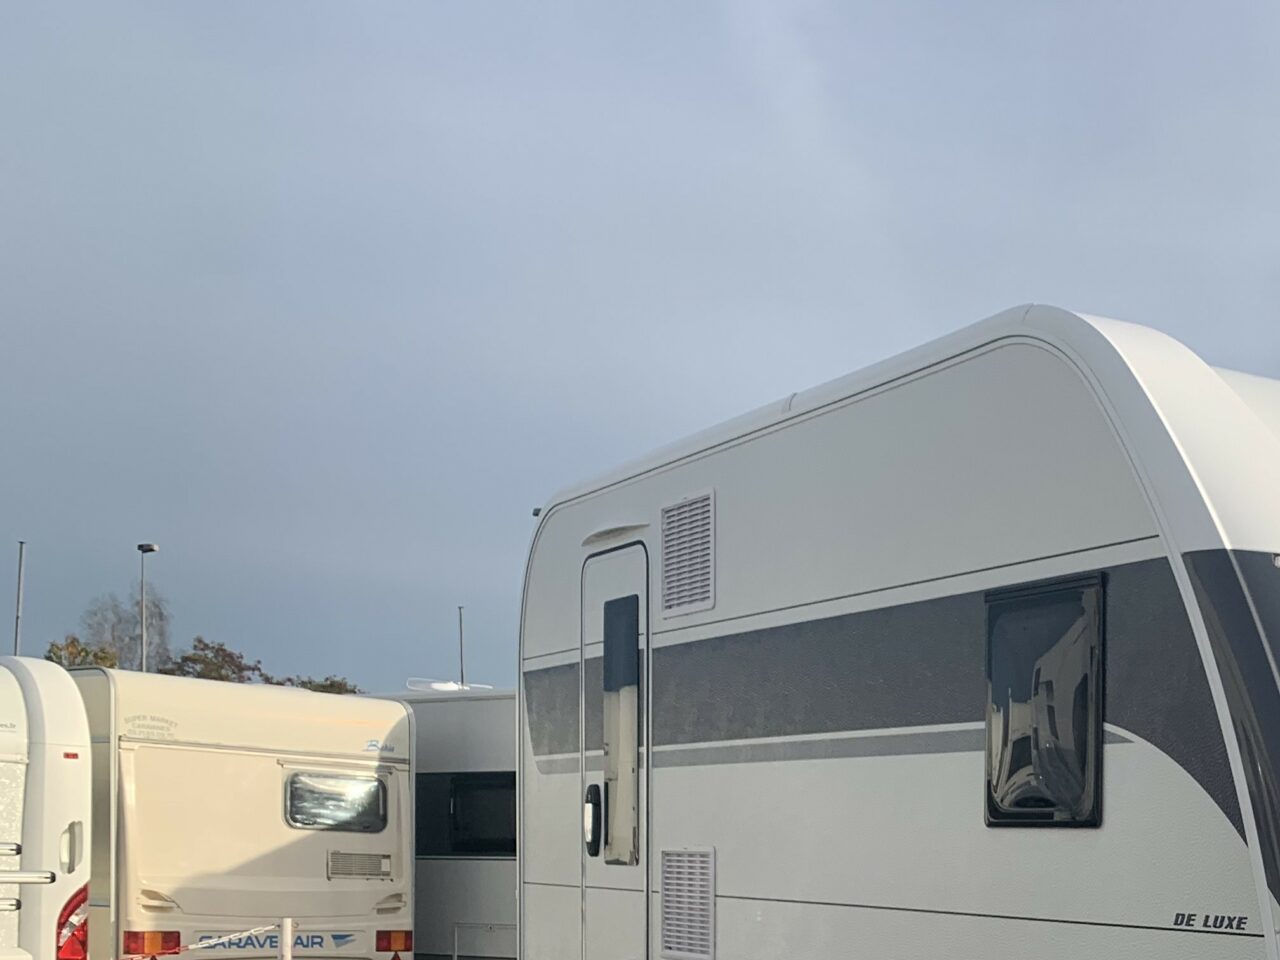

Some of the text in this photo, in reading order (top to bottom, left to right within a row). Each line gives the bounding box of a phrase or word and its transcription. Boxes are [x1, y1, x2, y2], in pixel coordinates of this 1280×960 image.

[1173, 913, 1248, 930] DE LUXE
[199, 935, 324, 949] CARAVEAIR
